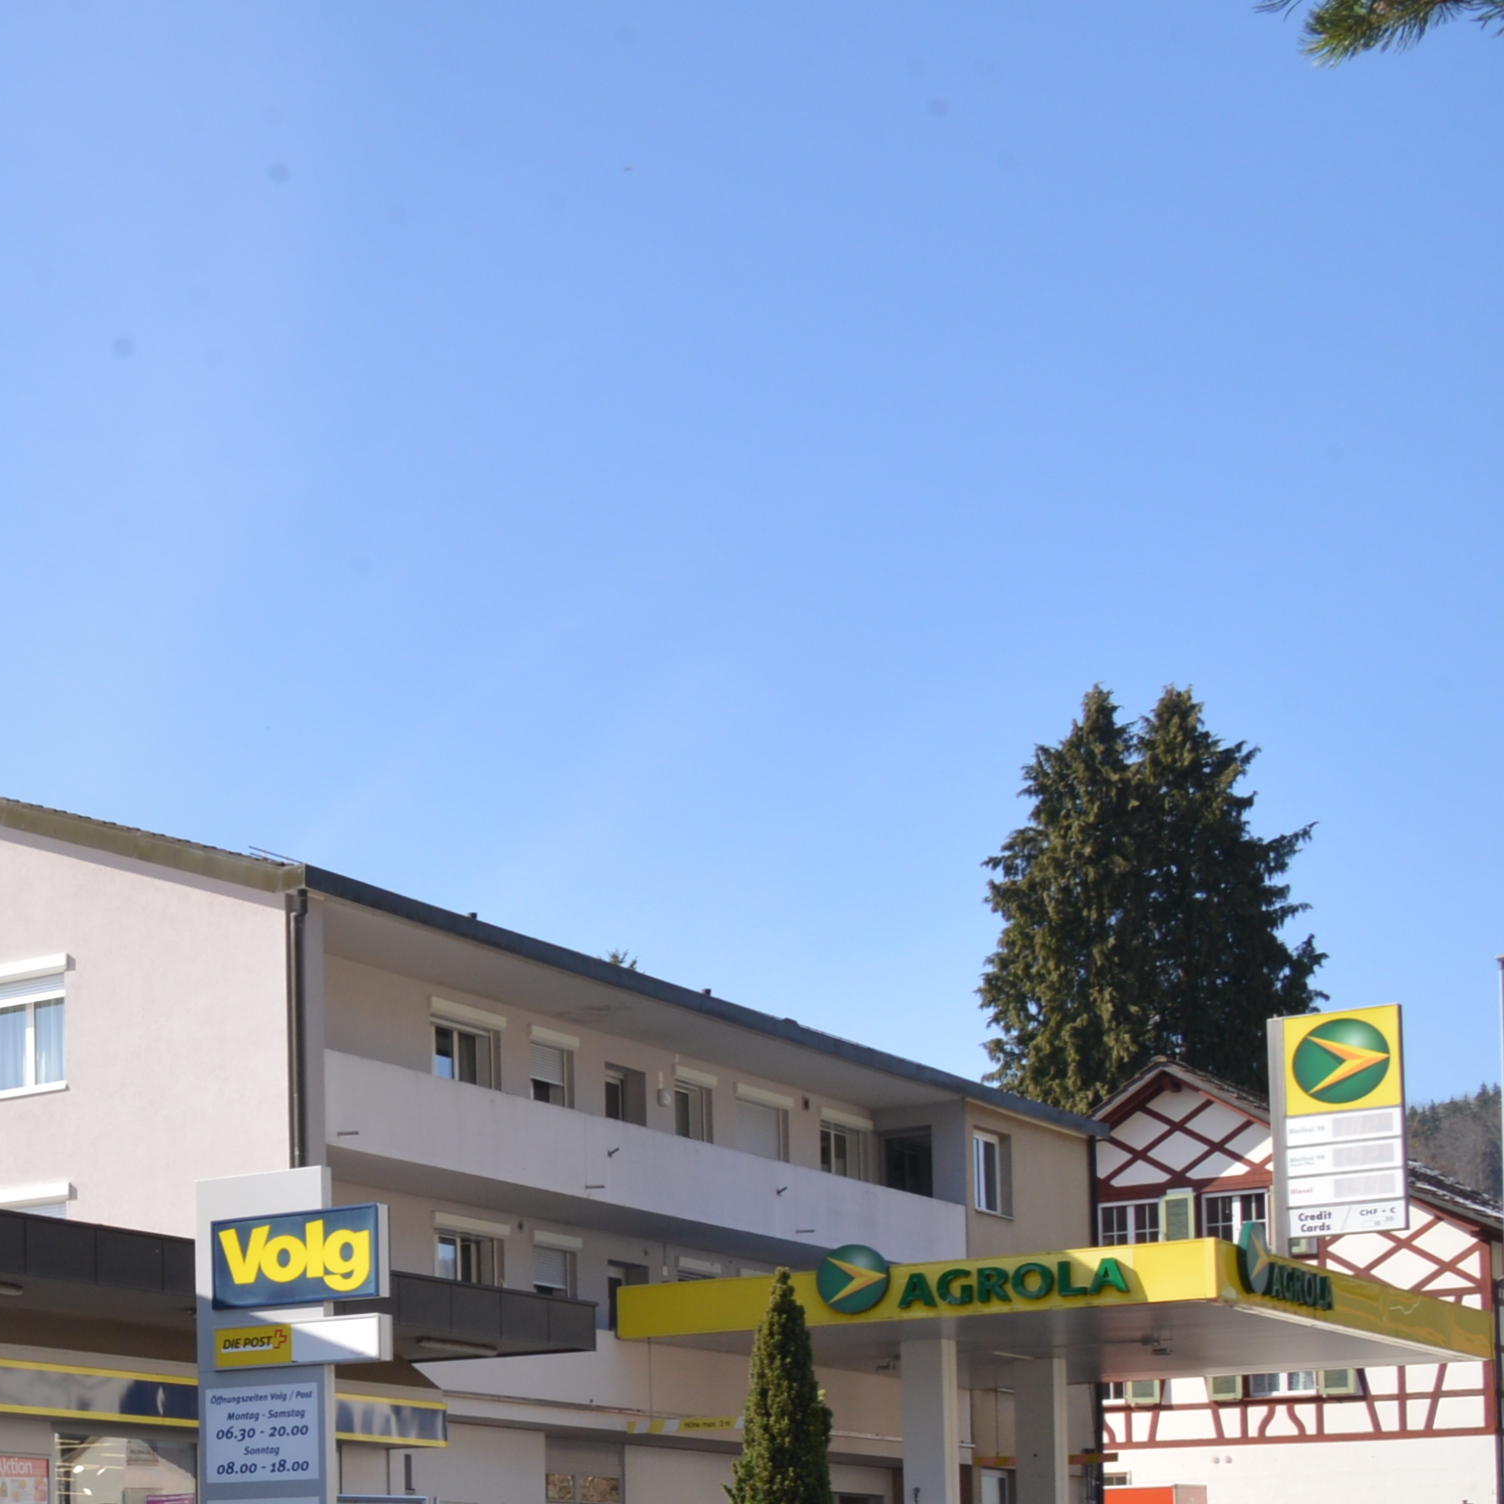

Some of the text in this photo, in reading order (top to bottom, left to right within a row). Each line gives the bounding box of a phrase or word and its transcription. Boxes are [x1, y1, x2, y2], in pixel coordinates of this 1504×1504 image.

[1291, 1187, 1313, 1195] Diesel
[1298, 1210, 1332, 1222] Credit
[1359, 1208, 1378, 1217] CHF
[1300, 1222, 1332, 1233] Cards
[218, 1219, 370, 1292] Volg
[897, 1257, 1130, 1309] AGROLA
[1268, 1261, 1336, 1311] AGROLA
[223, 1336, 273, 1350] DIE POST
[210, 1394, 268, 1406] Öffnungszeiten
[269, 1392, 287, 1402] Volg
[295, 1390, 313, 1399] Post
[227, 1412, 259, 1422] Montag
[267, 1409, 305, 1419] Samstag
[216, 1426, 256, 1442] 06.30
[268, 1425, 309, 1437] 20.00
[243, 1446, 280, 1456] Sonntag
[217, 1461, 257, 1475] 08.00
[270, 1459, 310, 1473] 18.00
